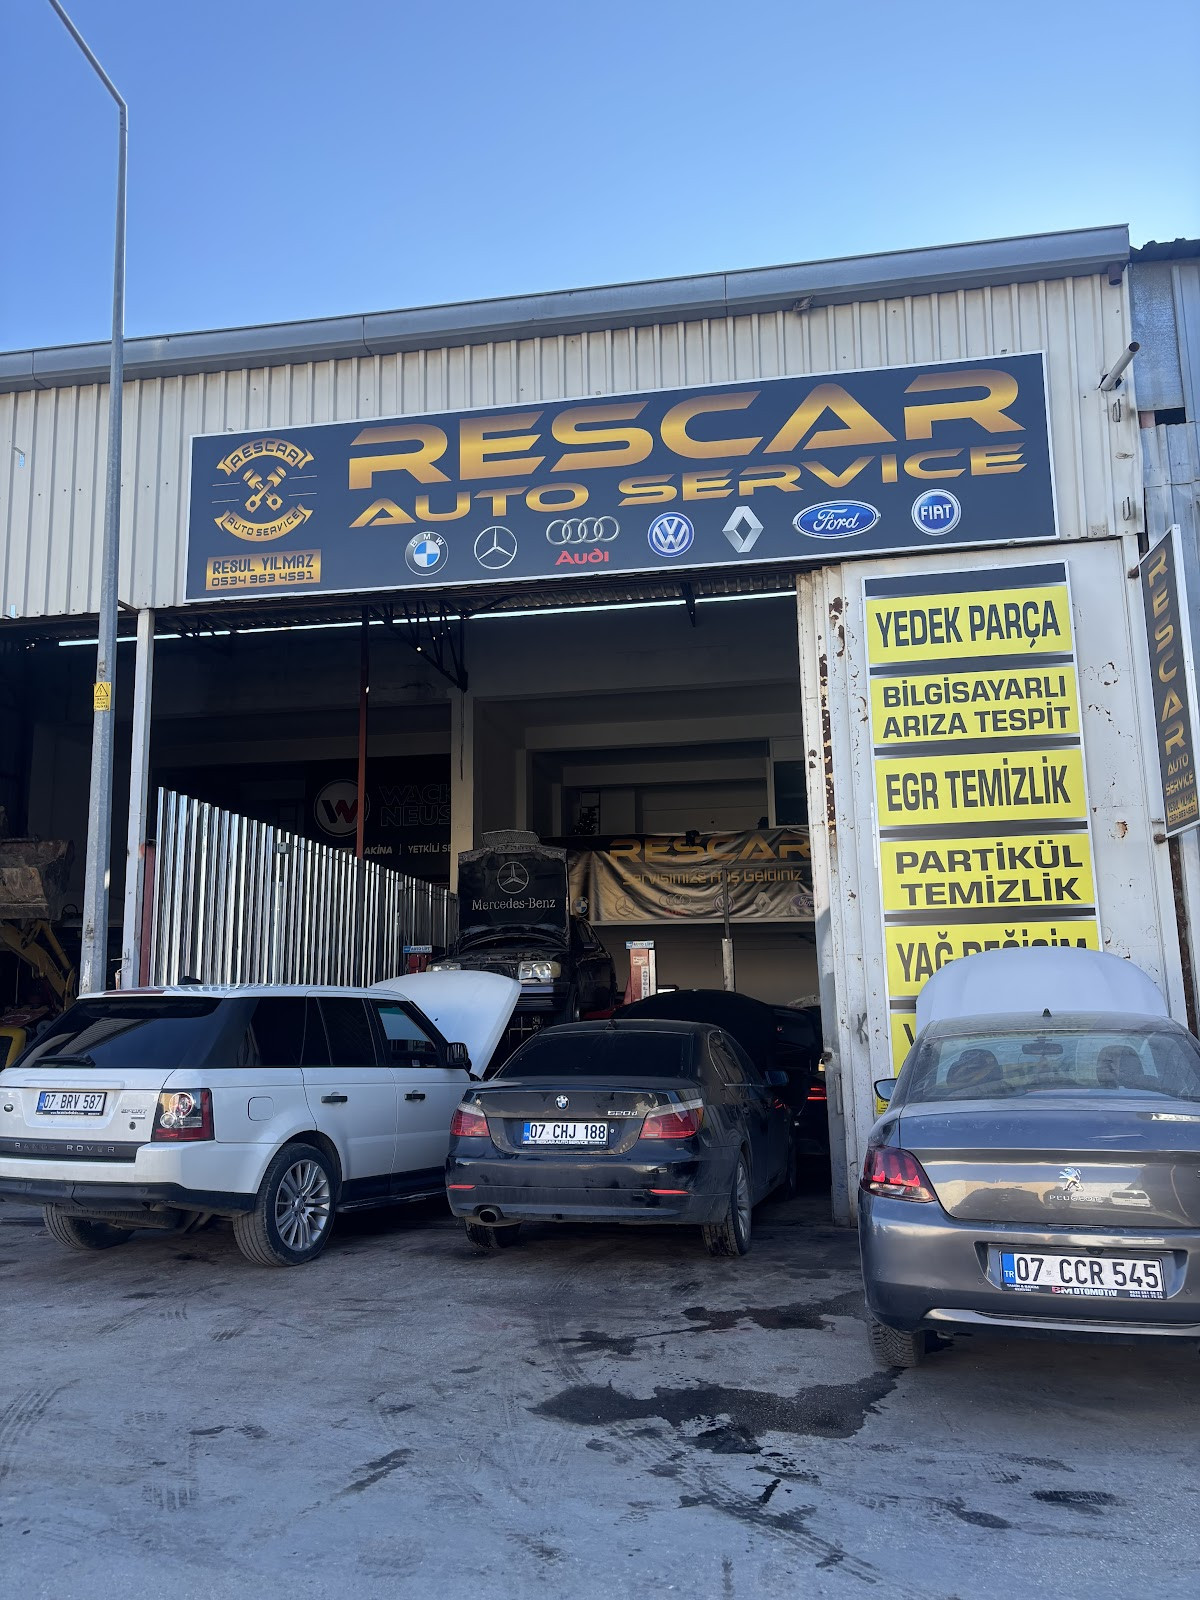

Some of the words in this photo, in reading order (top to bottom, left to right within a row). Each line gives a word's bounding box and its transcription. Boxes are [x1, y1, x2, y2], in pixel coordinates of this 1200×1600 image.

[349, 369, 1027, 490] RESCAR
[230, 440, 299, 468] RESCAR
[349, 482, 590, 528] AUTO
[618, 443, 1028, 507] SERVICE
[227, 517, 254, 536] AUTO
[255, 510, 301, 537] SERVICE
[812, 508, 860, 532] Ford
[920, 505, 953, 521] FIAT
[212, 556, 255, 575] RESUL
[262, 554, 314, 571] YILMAZ
[554, 547, 609, 566] Audi
[211, 575, 247, 587] 0534
[250, 573, 275, 584] 963
[279, 571, 314, 582] 4591
[876, 606, 963, 648] YEDEK
[968, 600, 1061, 648] PARÇA
[1147, 547, 1187, 756] RESCAR
[883, 675, 1067, 708] BİLGİSAYARLI
[883, 712, 968, 739] ARIZA
[974, 701, 1071, 733] TESPİT
[1168, 753, 1189, 776] AUTO
[885, 772, 939, 812] EGR
[945, 756, 1071, 809] TEMİZLİK
[1166, 770, 1194, 797] SERVICE
[364, 844, 393, 855] AKİNA
[609, 834, 810, 863] RESCAR
[895, 840, 1083, 874] PARTİKÜL
[901, 872, 1082, 906] TEMİZLİK
[472, 897, 556, 911] Mercedes-Benz
[896, 930, 953, 983] YAĞ
[44, 1094, 56, 1109] 07
[60, 1094, 80, 1109] BRV
[83, 1095, 102, 1109] 587
[530, 1124, 546, 1139] 07
[553, 1124, 576, 1139] CHJ
[584, 1124, 606, 1139] 188
[66, 1144, 115, 1153] ROVER
[1049, 1194, 1101, 1202] PEUGEOT
[1004, 1270, 1015, 1279] TR
[1016, 1256, 1045, 1282] 07
[1059, 1258, 1104, 1286] CCR
[1112, 1261, 1159, 1289] 545
